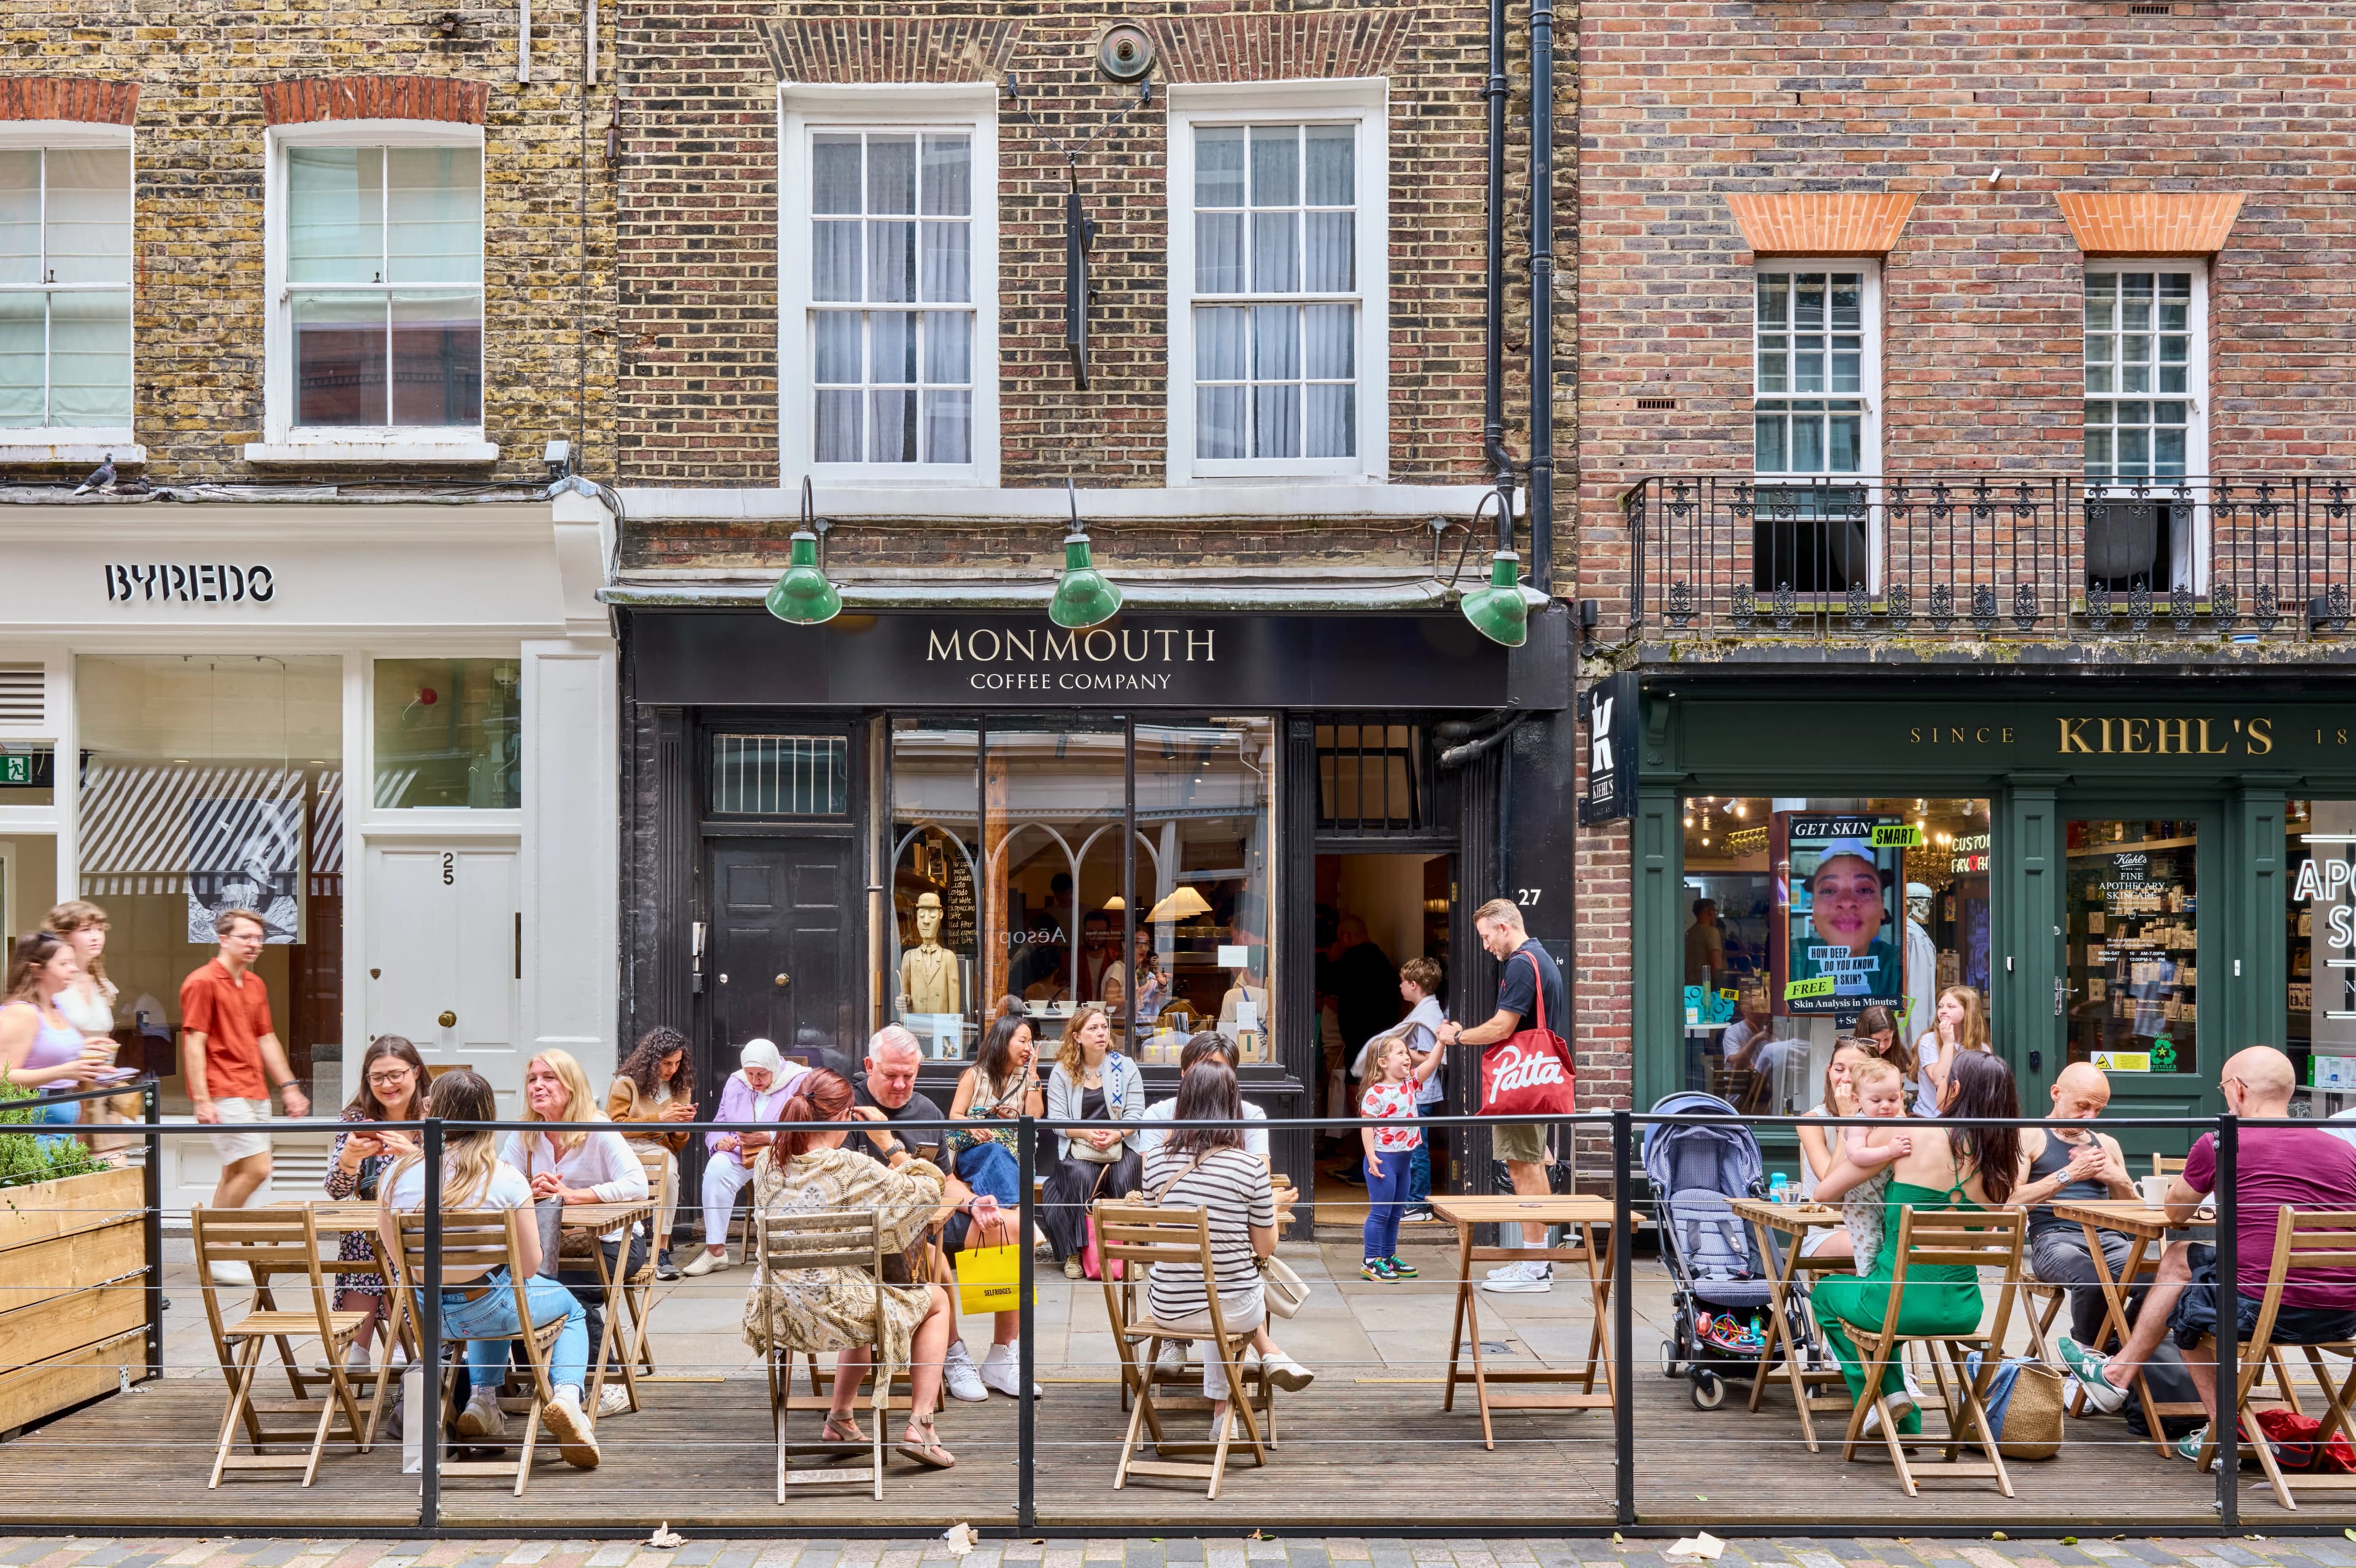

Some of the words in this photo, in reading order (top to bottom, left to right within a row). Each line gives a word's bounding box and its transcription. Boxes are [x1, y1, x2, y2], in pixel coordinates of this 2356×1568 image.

[106, 564, 274, 602] BYREDO
[926, 629, 1216, 662] MONMOUTH
[971, 674, 1051, 690] COFFEE
[1060, 674, 1171, 690] COMPANY
[1911, 728, 2013, 743] SINCE
[2057, 718, 2273, 755] KIEHL'S
[1593, 779, 1614, 799] KIEHL'S
[1795, 823, 1829, 836] GET
[1831, 822, 1871, 836] SKIN
[1876, 828, 1915, 845] SMART
[2114, 853, 2147, 865] Kiehl's
[2293, 859, 2356, 901] AP
[1519, 889, 1542, 905] 27
[1811, 948, 1828, 958] HOW
[1830, 948, 1847, 958] DEEP
[1825, 961, 1834, 971] DO
[1837, 959, 1850, 970] YOU
[1852, 958, 1874, 970] KNOW
[1841, 974, 1861, 985] SKIN?
[1723, 990, 1736, 999] NEW
[1792, 982, 1827, 996] FREE
[1794, 999, 1814, 1008] Skin
[1815, 999, 1850, 1009] Analysis
[1846, 1016, 1858, 1024] Sa
[1488, 1045, 1565, 1104] Patta
[984, 1287, 1011, 1296] SELFRIDGES
